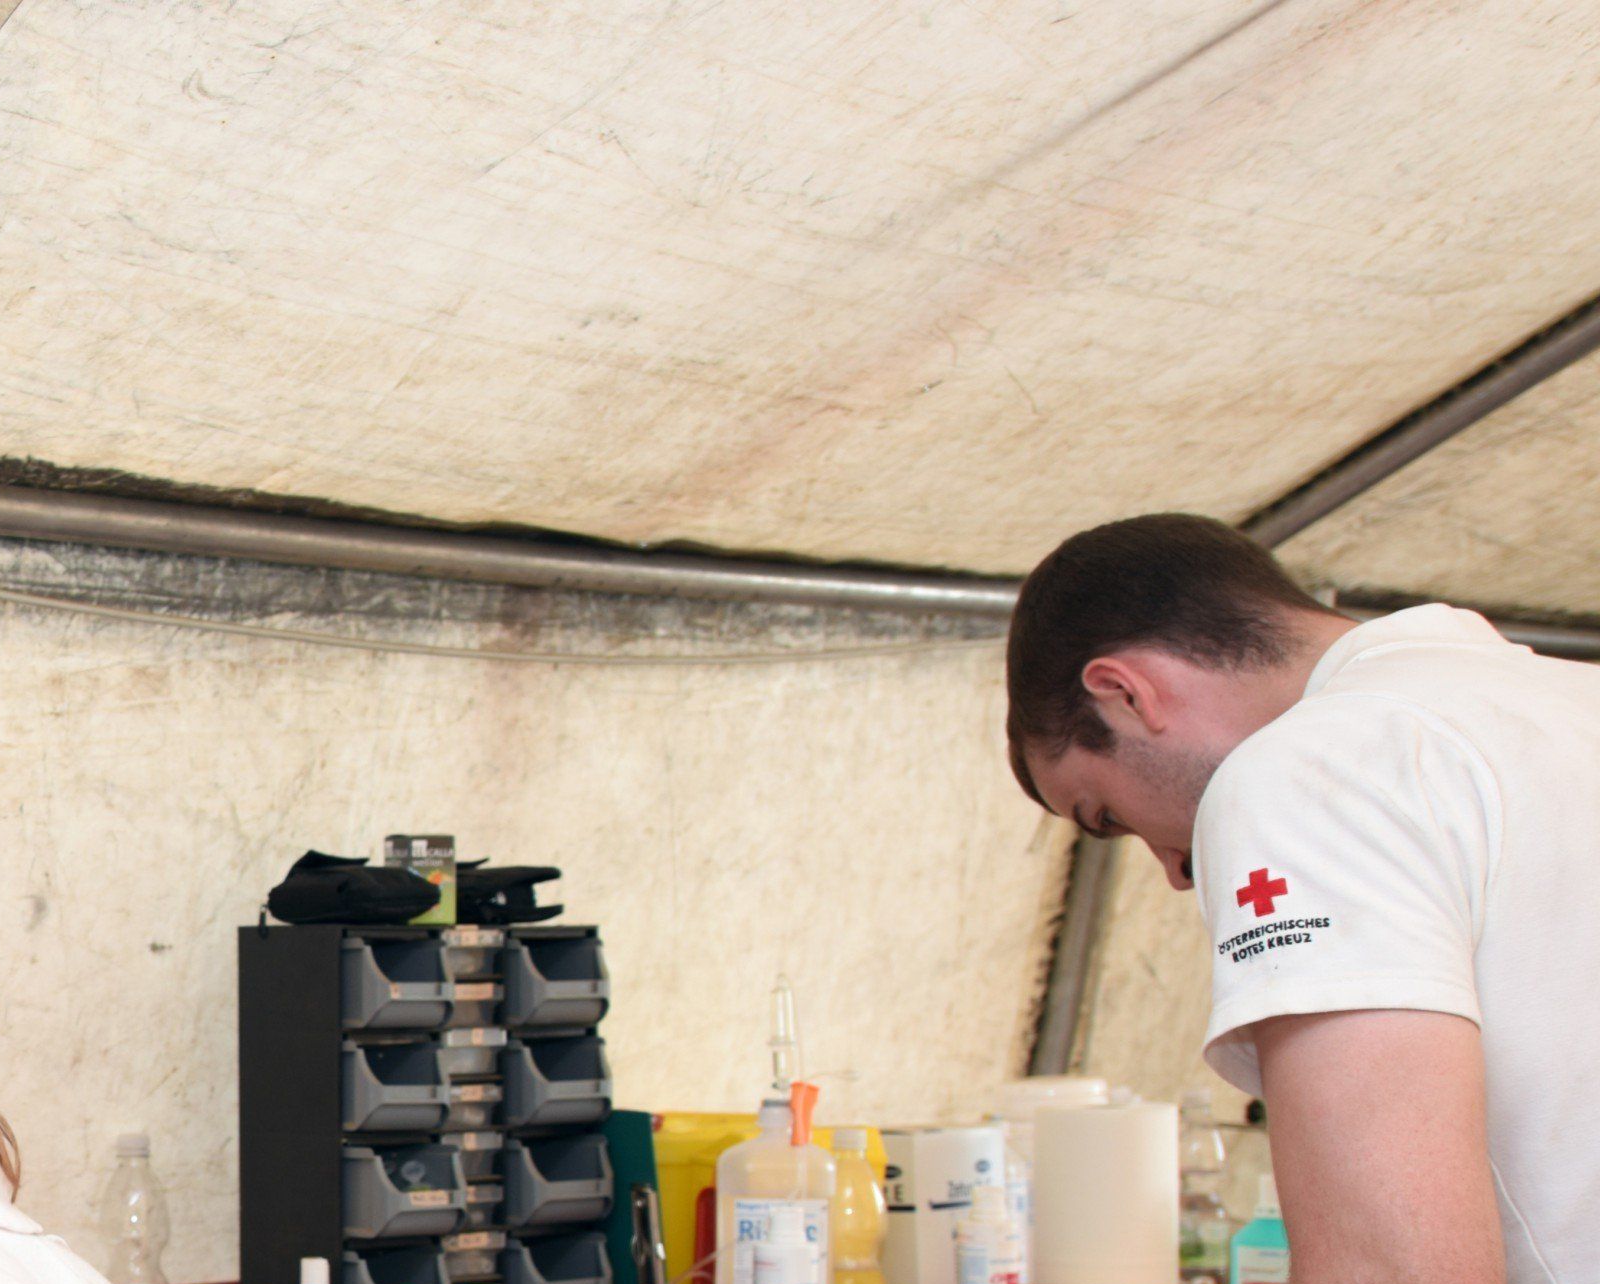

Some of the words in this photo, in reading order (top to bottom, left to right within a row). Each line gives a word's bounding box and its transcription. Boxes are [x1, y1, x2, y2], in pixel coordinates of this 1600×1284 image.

[1217, 917, 1331, 955] ÖSTERREICHISCHES
[1231, 941, 1266, 963] ROTES
[1267, 932, 1312, 959] KREUZ
